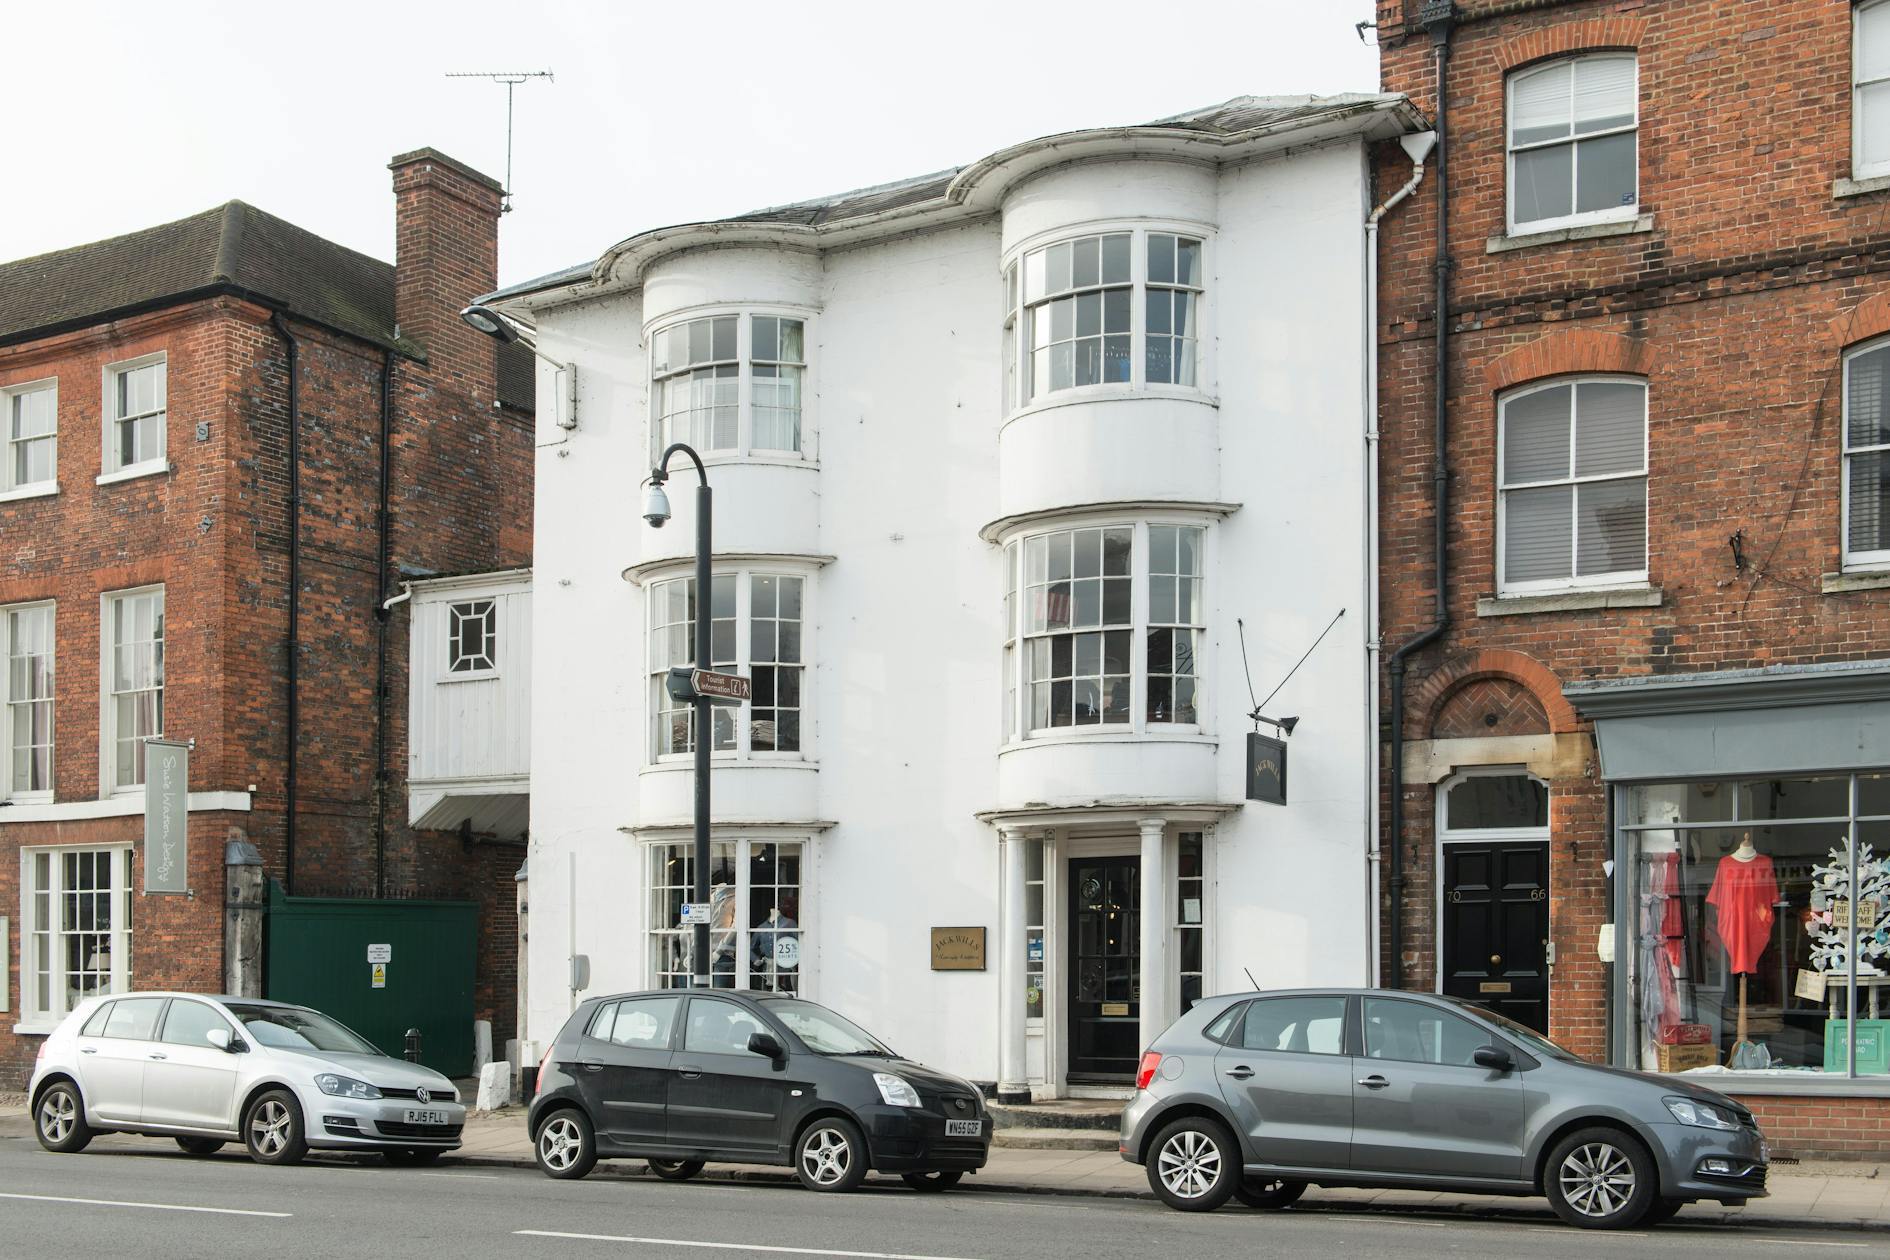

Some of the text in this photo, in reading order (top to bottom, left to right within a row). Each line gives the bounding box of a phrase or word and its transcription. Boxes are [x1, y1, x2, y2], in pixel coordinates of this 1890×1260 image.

[706, 675, 725, 685] Tourist
[162, 755, 176, 790] Susie
[162, 793, 176, 839] Watson
[1447, 891, 1461, 902] 70
[1530, 889, 1546, 900] 66
[935, 935, 979, 951] JACK WILLS
[408, 1111, 444, 1123] RJ15 FLL
